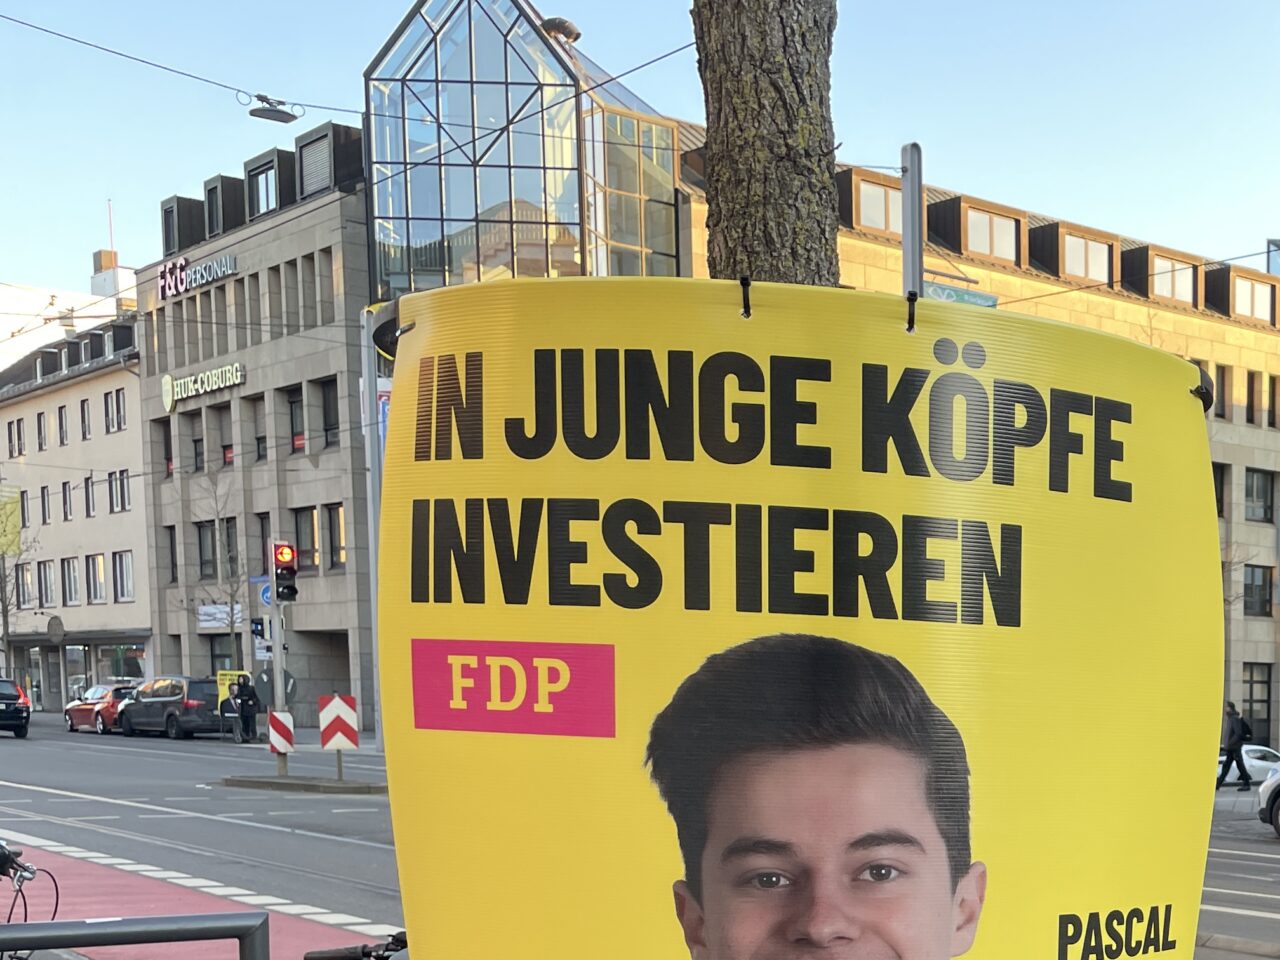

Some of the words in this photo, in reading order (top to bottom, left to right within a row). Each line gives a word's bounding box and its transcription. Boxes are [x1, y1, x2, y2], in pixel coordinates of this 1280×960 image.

[157, 256, 187, 300] F&G
[186, 255, 233, 289] PERSONAL
[172, 362, 242, 400] HUK-COBURG
[414, 351, 483, 462] IN
[504, 348, 832, 468] JUNGE
[861, 337, 1132, 503] KÖPFE
[410, 497, 1023, 628] INVESTIEREN
[447, 654, 571, 713] FDP
